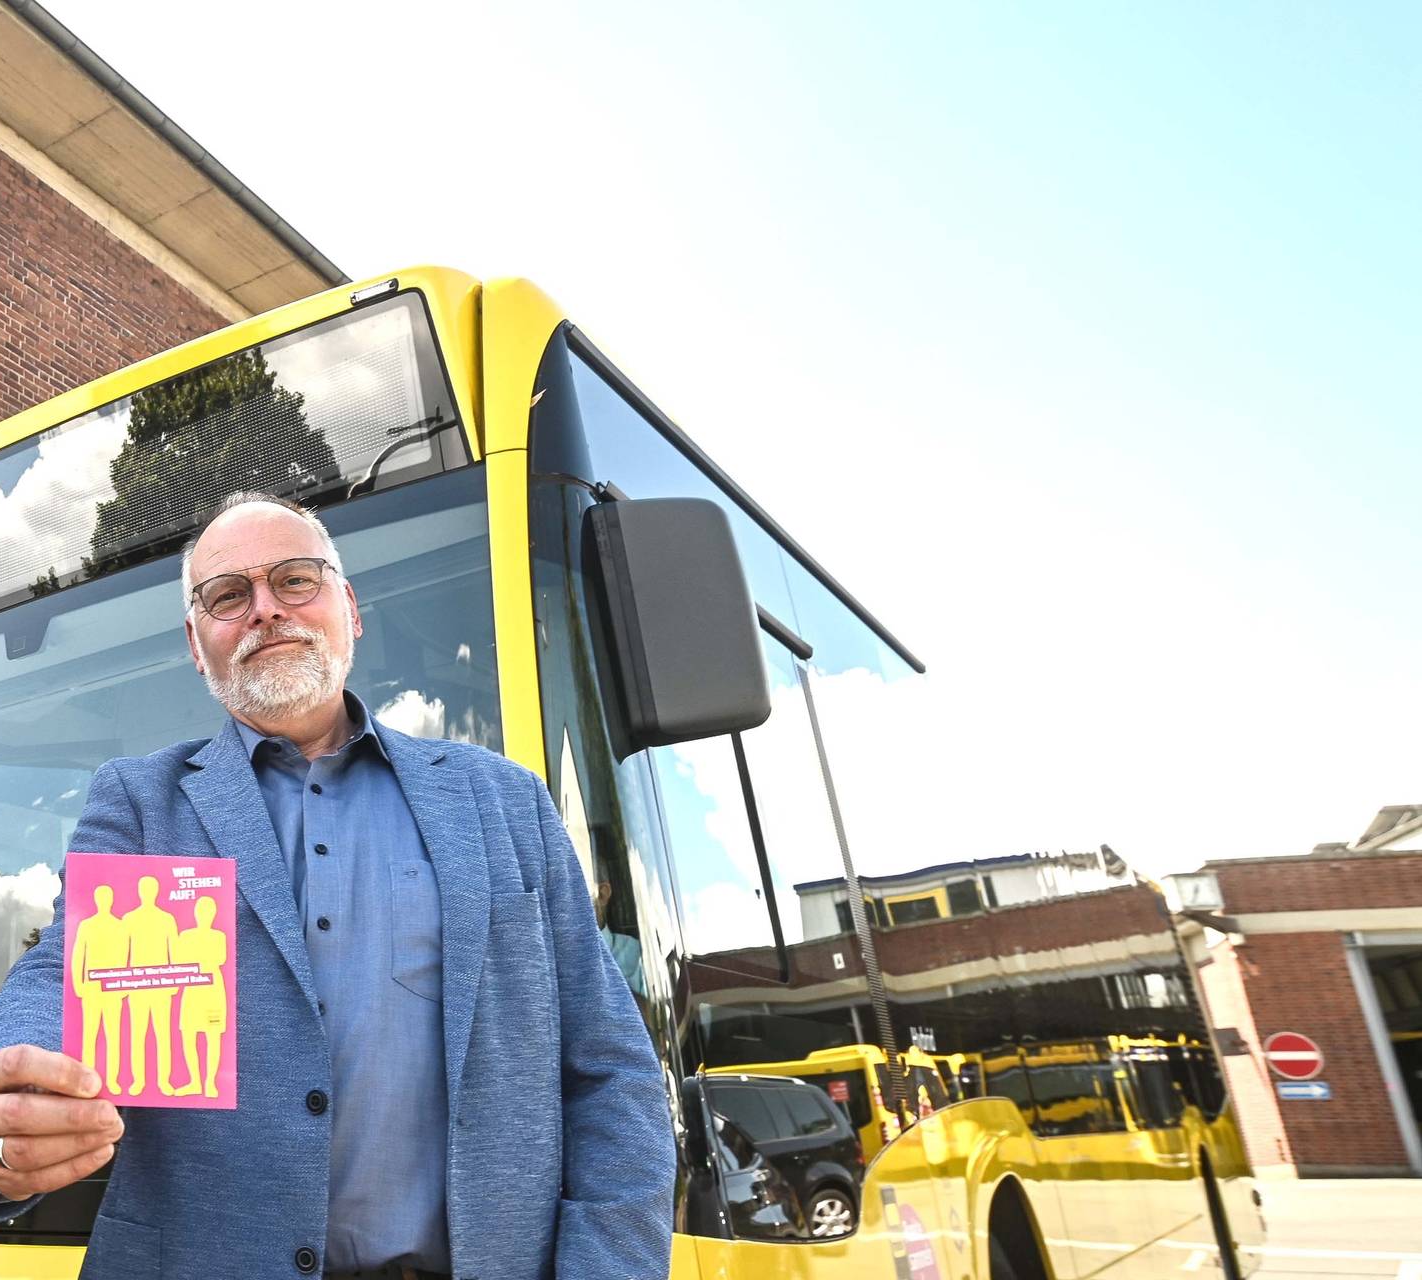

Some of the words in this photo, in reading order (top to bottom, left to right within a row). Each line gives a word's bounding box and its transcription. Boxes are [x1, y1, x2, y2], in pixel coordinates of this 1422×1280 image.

[171, 867, 195, 877] WIR
[178, 876, 222, 889] STEHEN
[169, 889, 196, 901] AUF!
